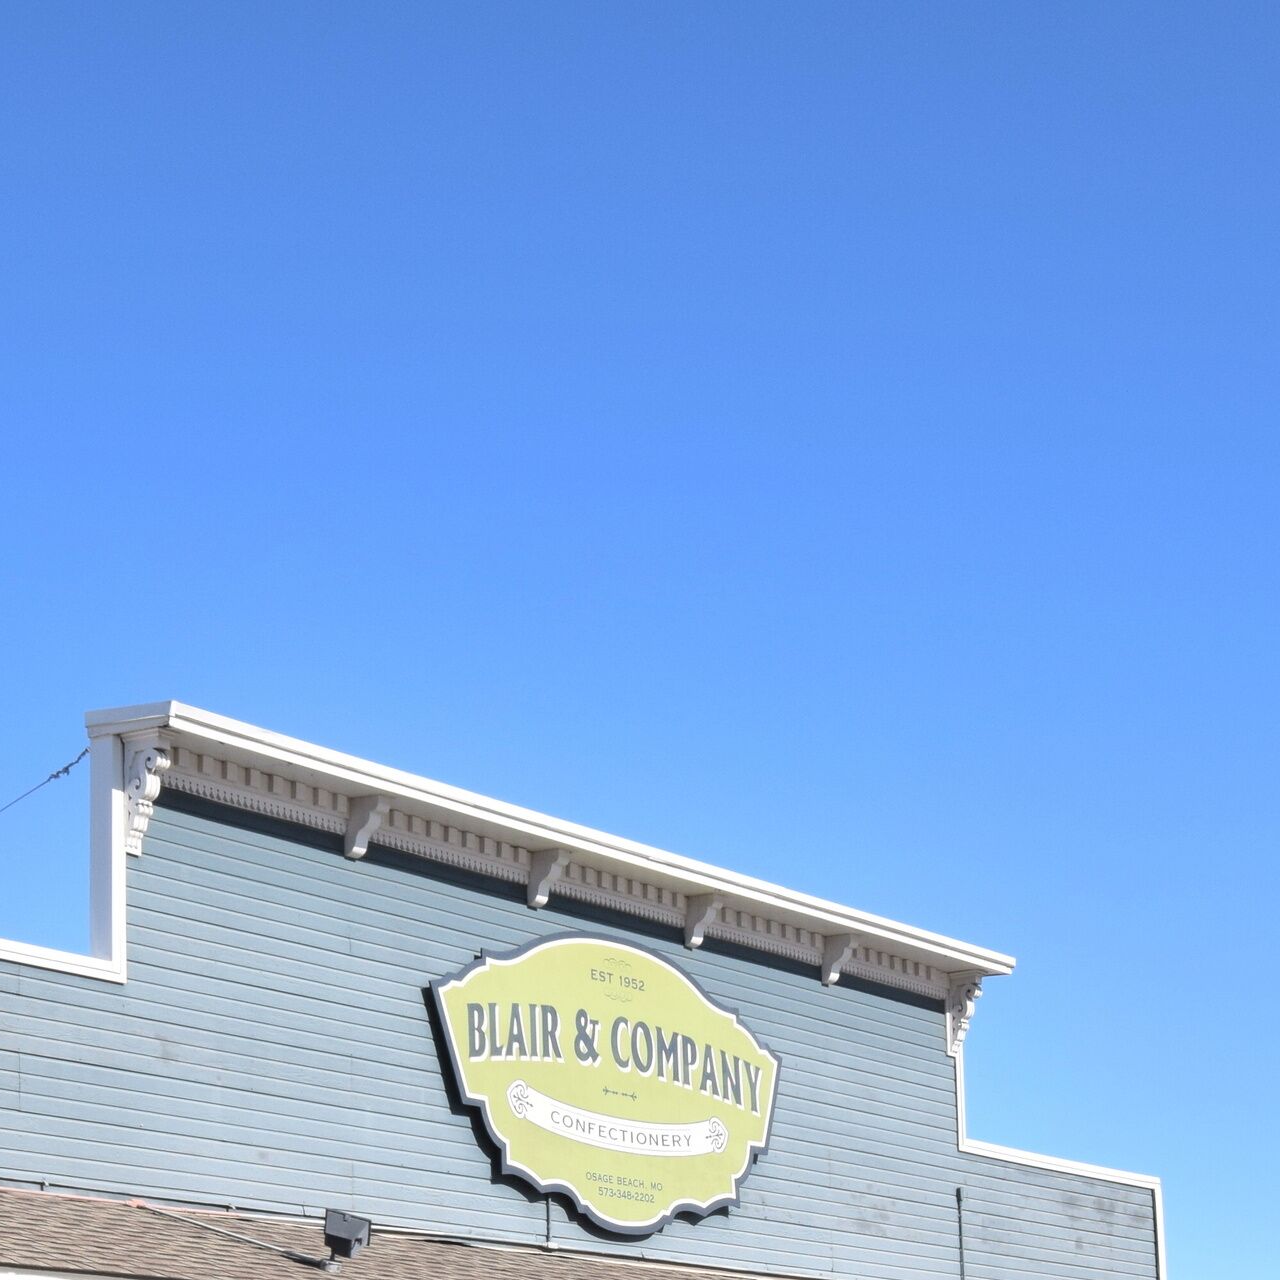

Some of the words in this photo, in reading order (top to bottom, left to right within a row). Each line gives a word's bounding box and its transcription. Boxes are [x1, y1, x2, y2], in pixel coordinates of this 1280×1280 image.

[590, 968, 614, 985] EST
[619, 975, 646, 992] 1952
[466, 1002, 565, 1063] BLAIR
[573, 1008, 603, 1067] &
[611, 1016, 762, 1117] COMPANY
[550, 1110, 693, 1148] CONFECTIONERY
[585, 1171, 614, 1184] OSAGE
[650, 1182, 663, 1191] MO
